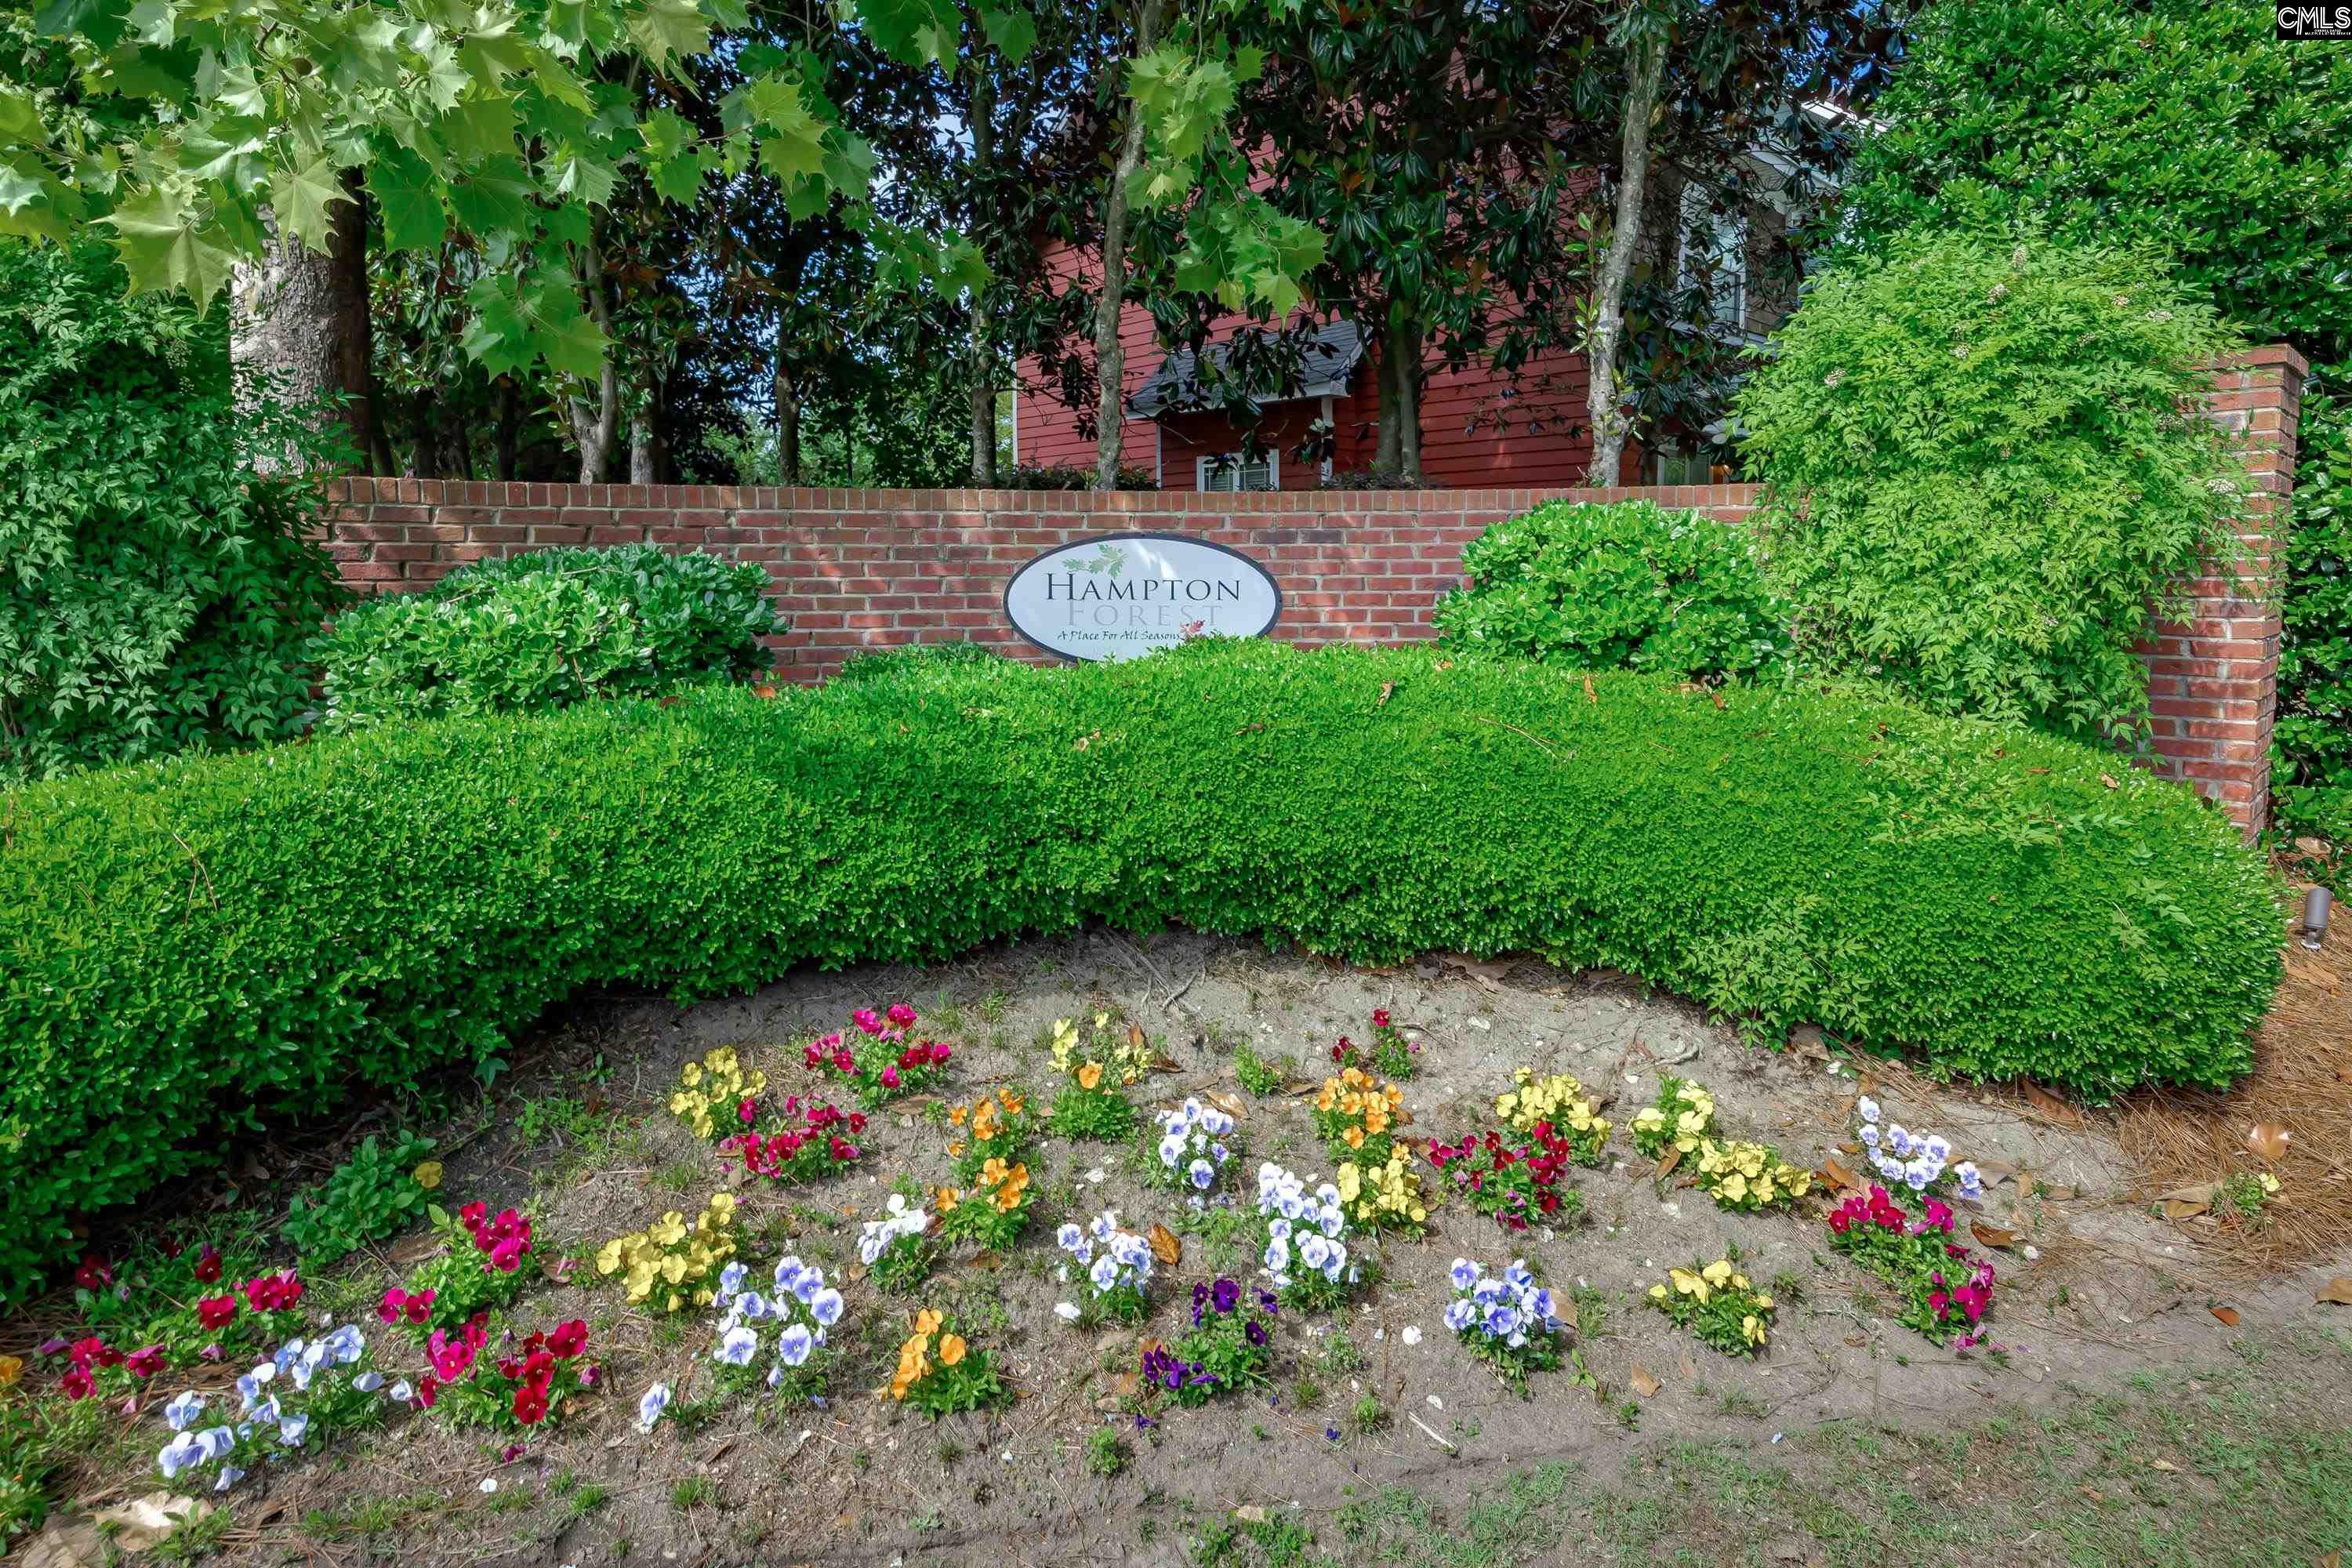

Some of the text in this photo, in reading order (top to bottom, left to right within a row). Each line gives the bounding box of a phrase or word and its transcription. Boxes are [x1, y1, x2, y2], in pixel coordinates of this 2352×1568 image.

[1047, 573, 1240, 601] HAMPTON
[1069, 600, 1222, 626] FOREST
[1058, 630, 1180, 641] A Place For All Seasons
